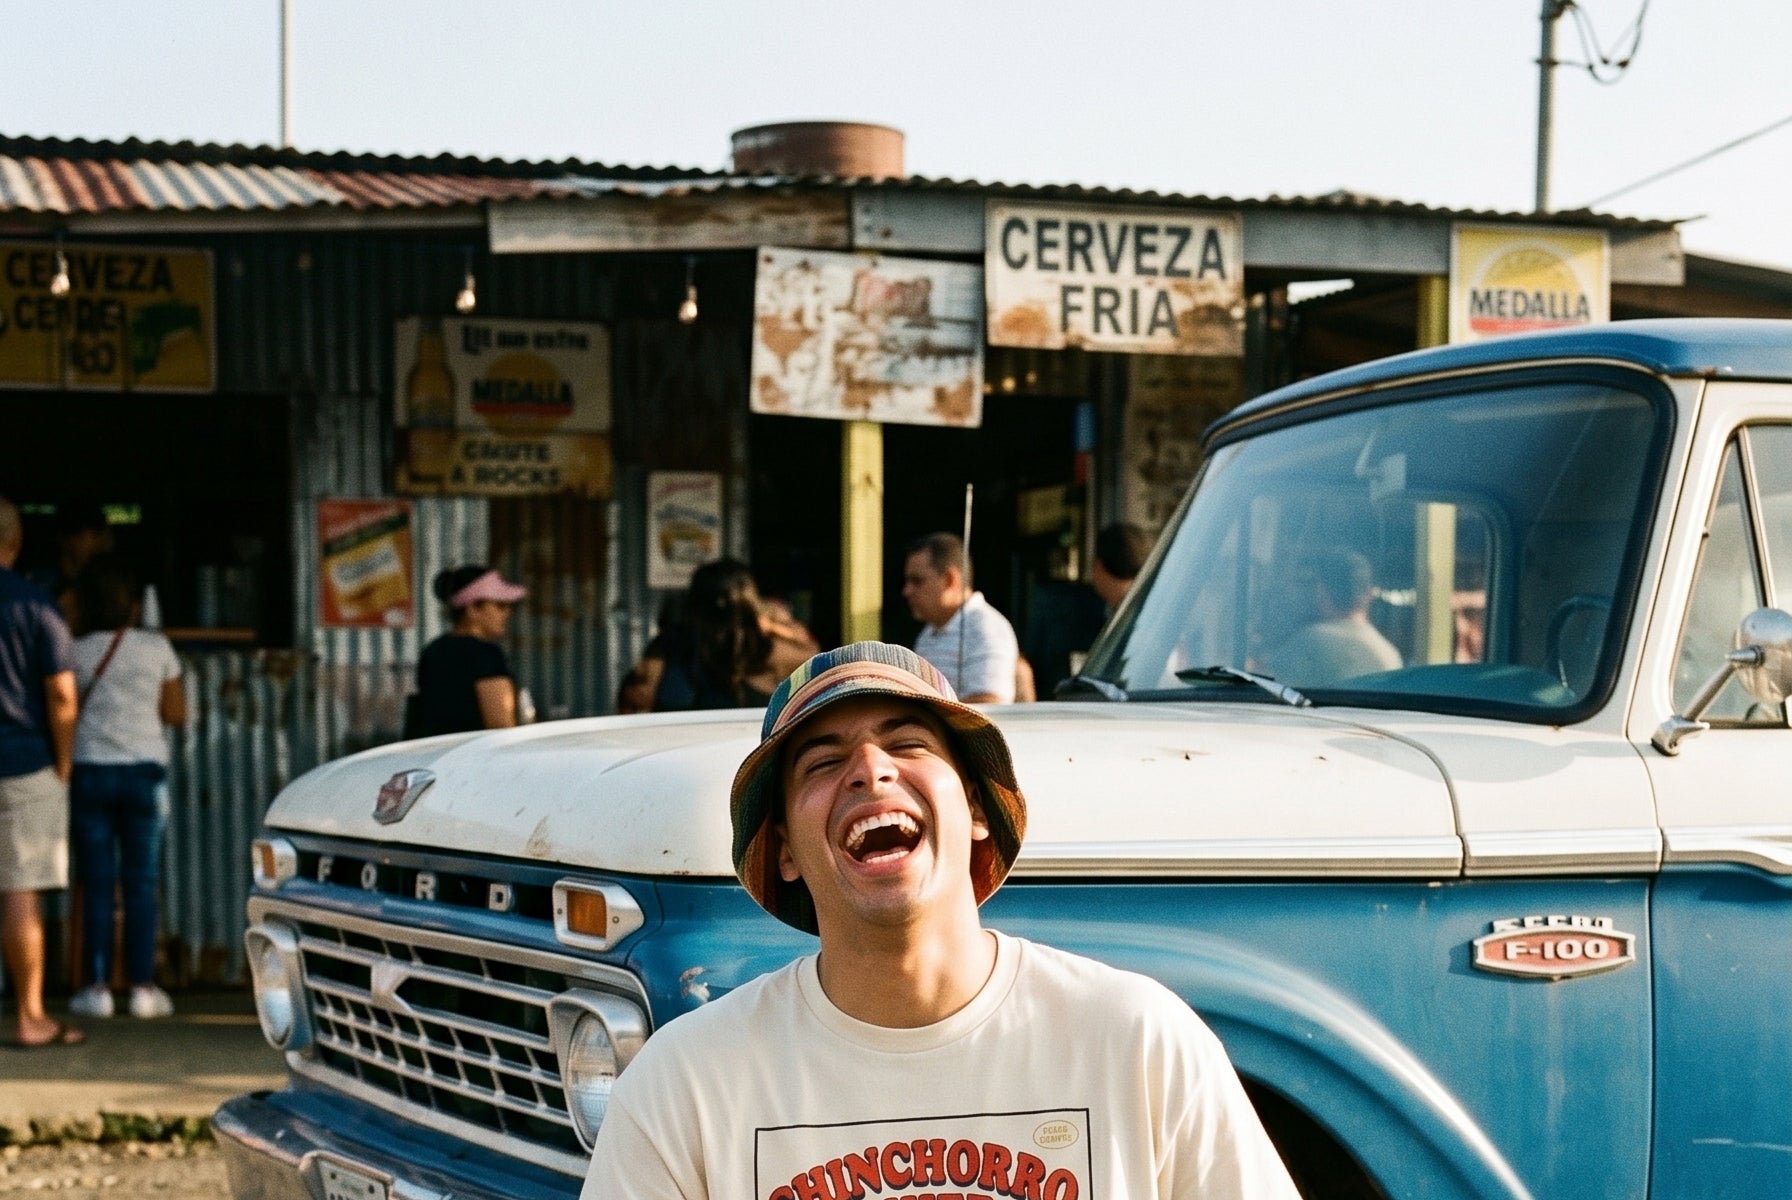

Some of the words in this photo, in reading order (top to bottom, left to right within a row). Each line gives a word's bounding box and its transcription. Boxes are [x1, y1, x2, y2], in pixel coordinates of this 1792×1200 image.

[1001, 216, 1227, 281] CERVEZA
[1061, 285, 1179, 338] FRIA
[1470, 288, 1591, 321] MEDALLA
[317, 855, 513, 912] FORD
[1505, 938, 1610, 961] F-100
